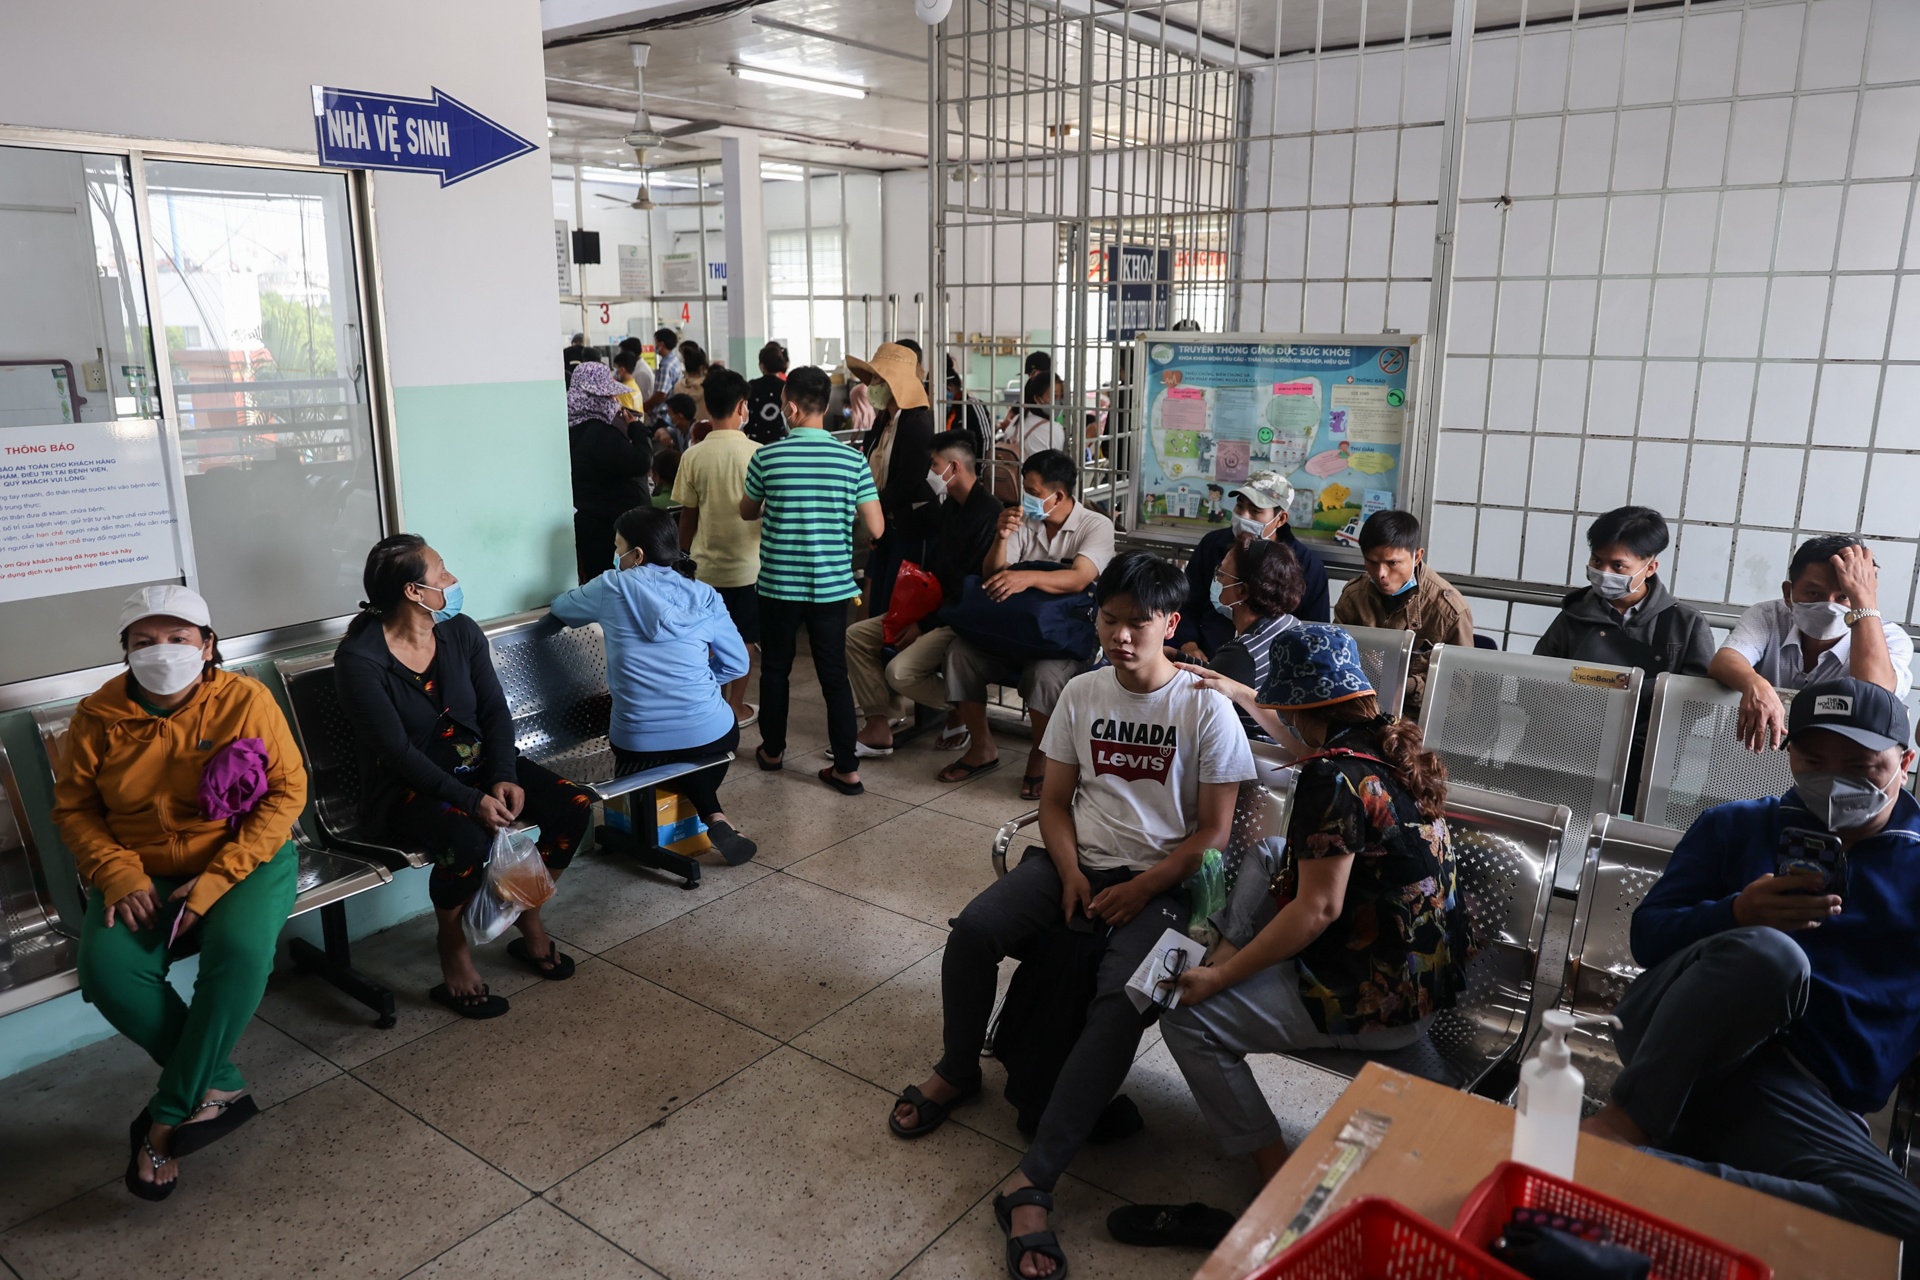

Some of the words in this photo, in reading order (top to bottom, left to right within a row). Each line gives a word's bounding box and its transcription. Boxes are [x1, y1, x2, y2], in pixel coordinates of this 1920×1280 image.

[326, 101, 371, 150] NHÀ
[373, 105, 402, 162] VỆ
[405, 117, 451, 158] SINH
[600, 302, 610, 324] 3
[681, 302, 691, 323] 4
[1216, 345, 1249, 354] THÔNG
[1276, 347, 1298, 357] DỤC
[1299, 346, 1320, 356] SỨC
[5, 444, 47, 455] THÔNG
[50, 442, 75, 452] BÁO
[68, 459, 94, 467] KHÁCH
[68, 467, 88, 475] BỆNH
[3, 479, 20, 487] QUÝ
[7, 571, 26, 579] dụng
[99, 559, 117, 567] Bệnh
[1090, 718, 1176, 747] CANADA
[1097, 750, 1165, 771] Levi's
